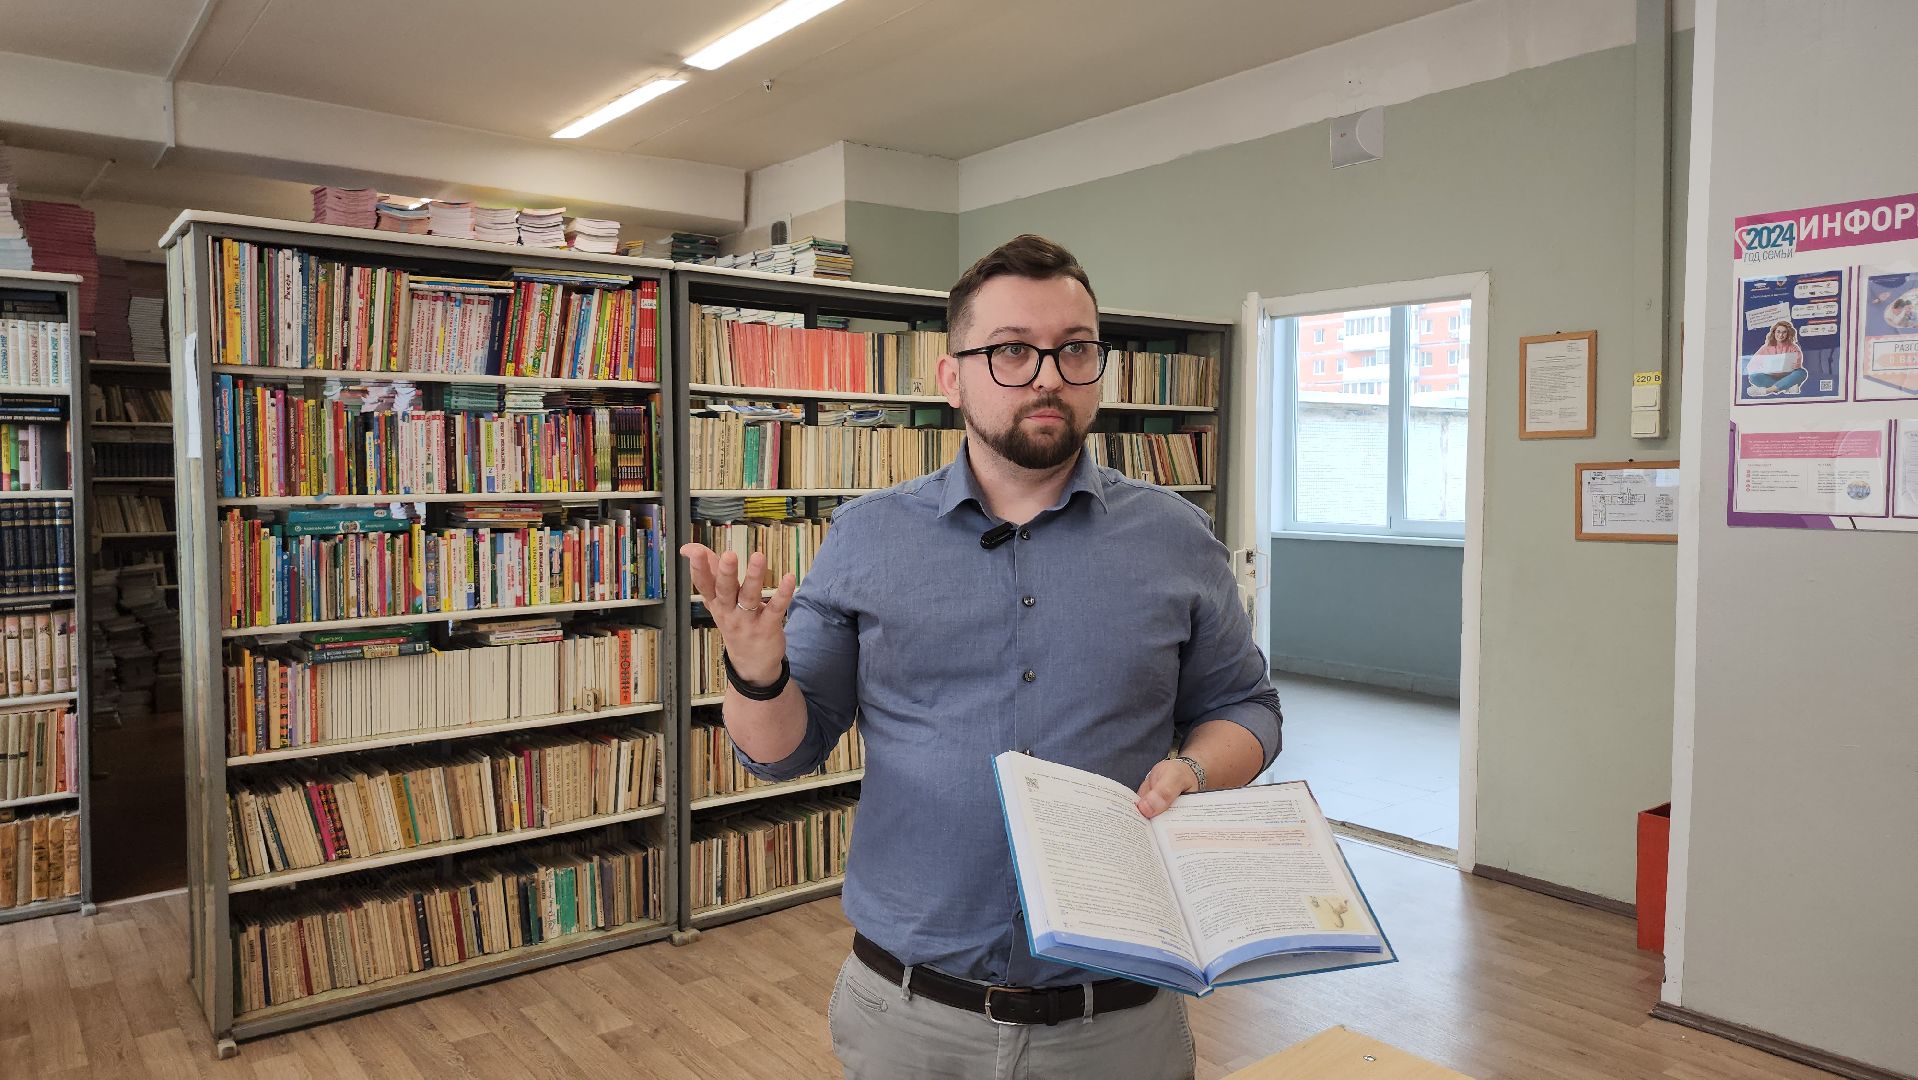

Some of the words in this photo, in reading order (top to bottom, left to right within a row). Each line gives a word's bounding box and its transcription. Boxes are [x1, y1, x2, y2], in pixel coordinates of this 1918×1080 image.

[1799, 202, 1918, 241] ИНФОР
[1745, 223, 1796, 251] 2024
[1635, 375, 1652, 383] 220
